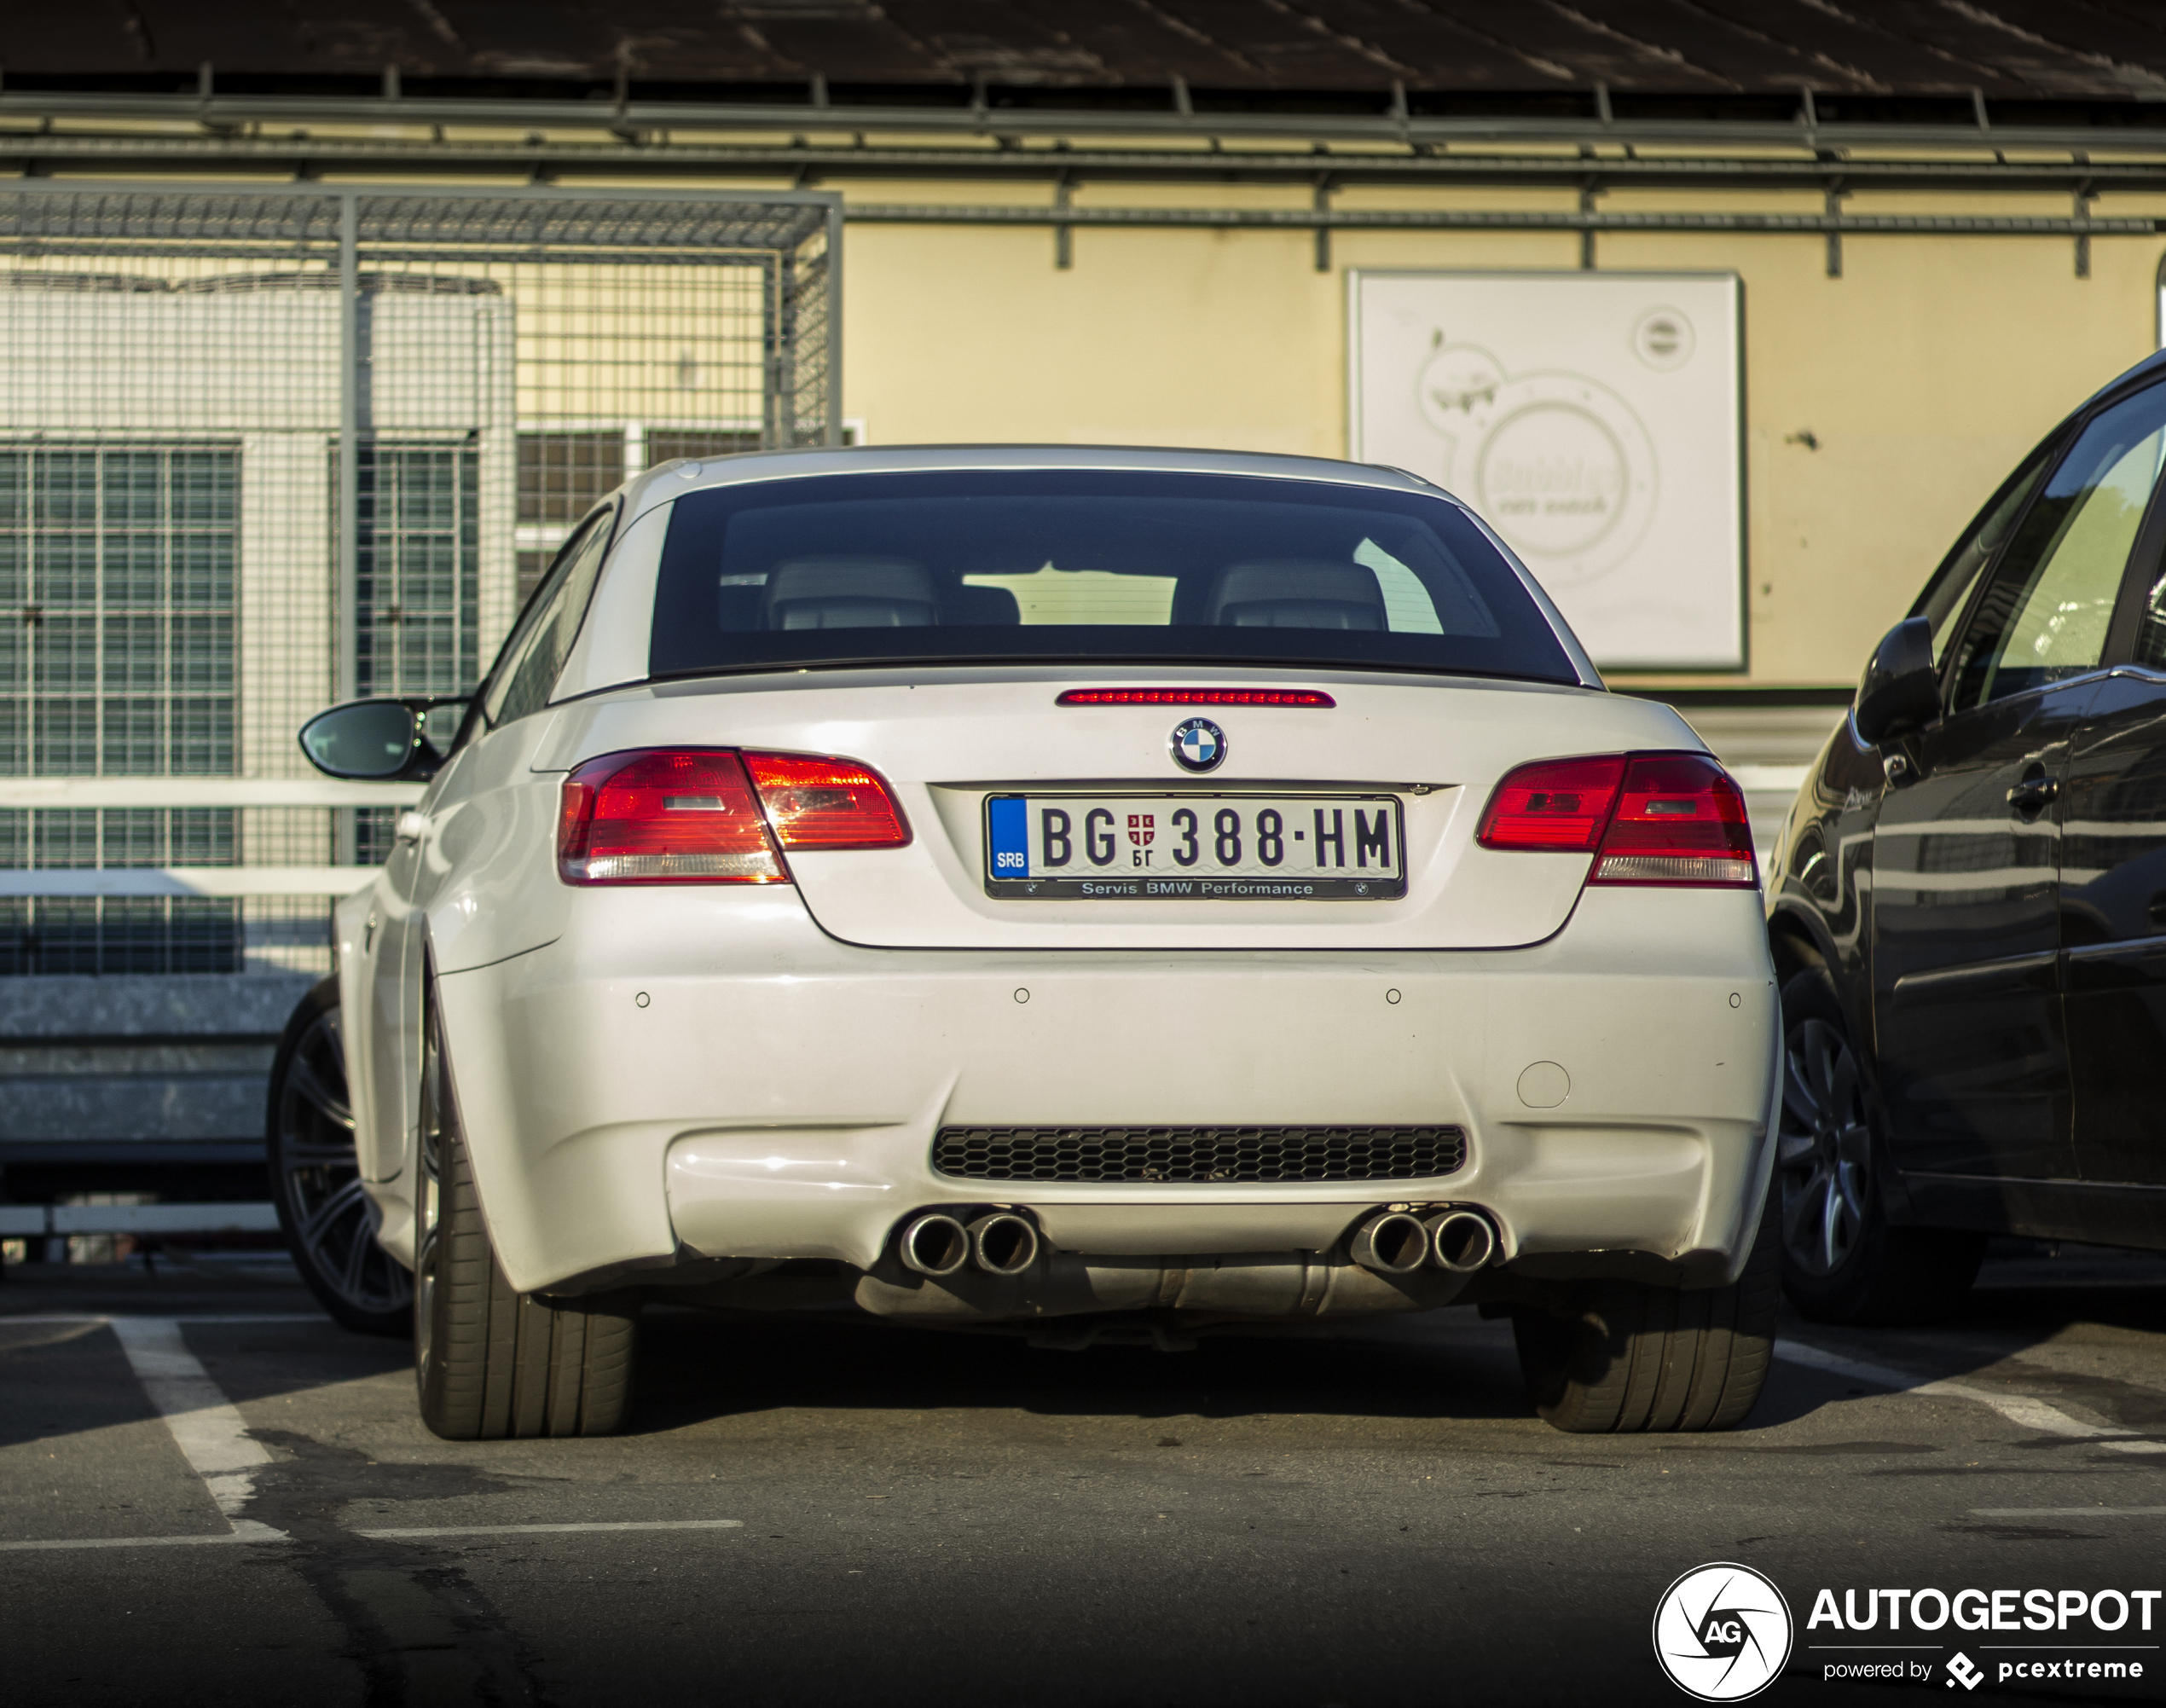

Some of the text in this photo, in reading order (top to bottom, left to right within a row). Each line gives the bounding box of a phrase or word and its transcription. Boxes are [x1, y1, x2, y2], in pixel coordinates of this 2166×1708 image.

[1042, 808, 1115, 866] BG
[997, 852, 1025, 868] SRB
[1082, 882, 1314, 895] Servis BMW Performance
